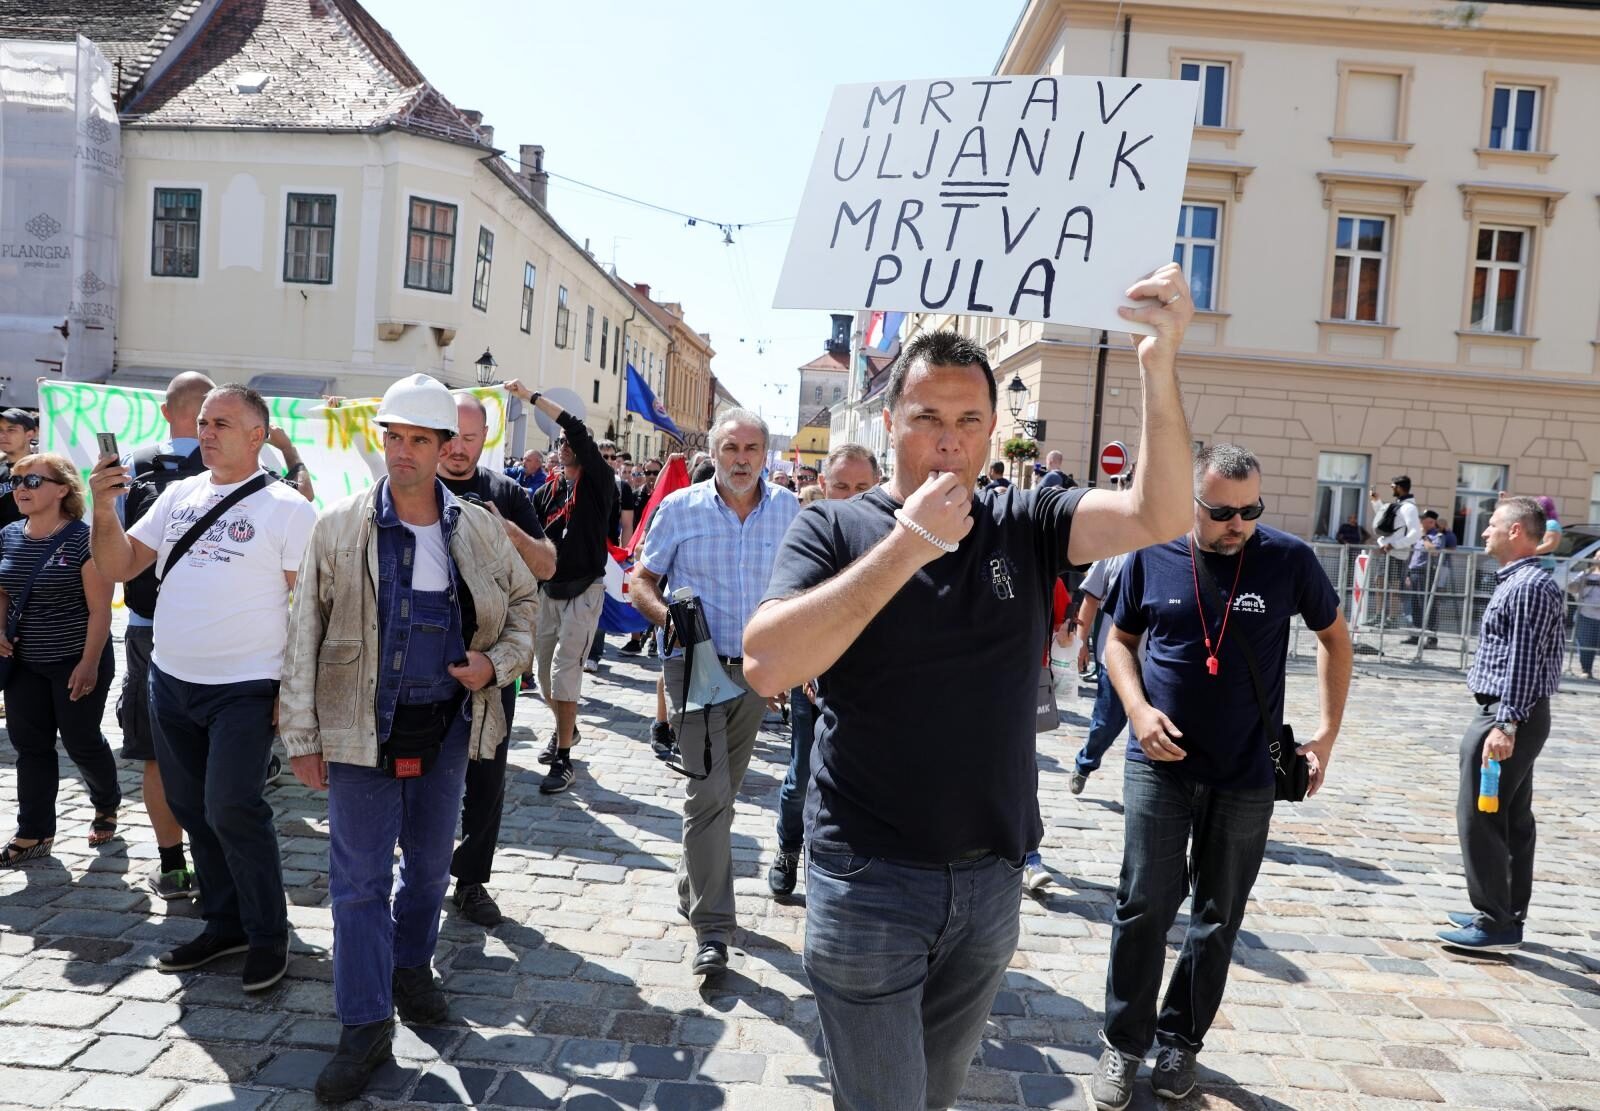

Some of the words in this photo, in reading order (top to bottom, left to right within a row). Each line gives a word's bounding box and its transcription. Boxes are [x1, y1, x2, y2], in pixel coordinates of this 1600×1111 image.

[862, 77, 1142, 128] MRTAV
[833, 126, 1154, 190] ULJANIK
[829, 198, 1094, 262] MRTVA
[864, 254, 1056, 318] PULA
[41, 385, 171, 450] PROD
